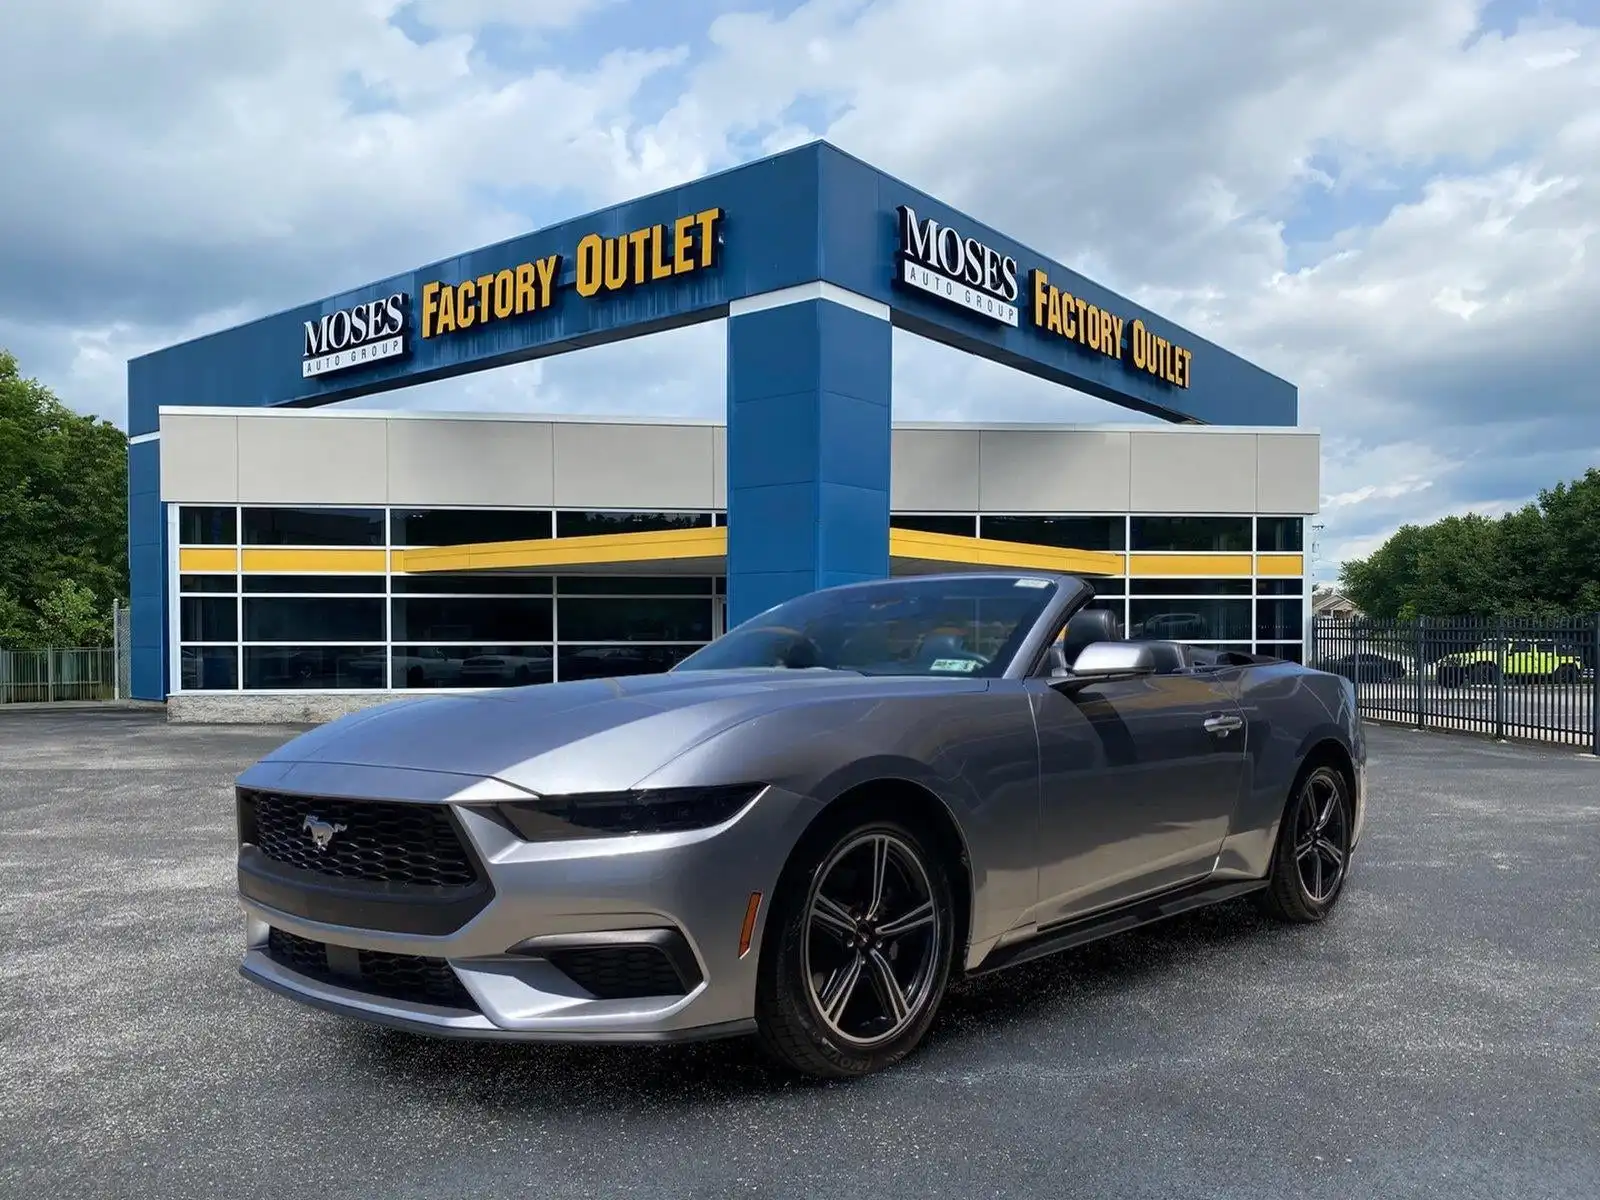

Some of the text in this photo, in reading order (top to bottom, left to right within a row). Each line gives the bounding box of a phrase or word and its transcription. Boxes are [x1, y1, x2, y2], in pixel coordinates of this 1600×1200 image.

[422, 207, 720, 338] FACTORY OUTLET
[904, 205, 1018, 301] MOSES
[303, 293, 404, 357] MOSES
[910, 266, 1014, 321] AUTO GROUP
[1034, 268, 1192, 389] FACTORY OUTLET
[306, 340, 399, 373] AUTO GROUP
